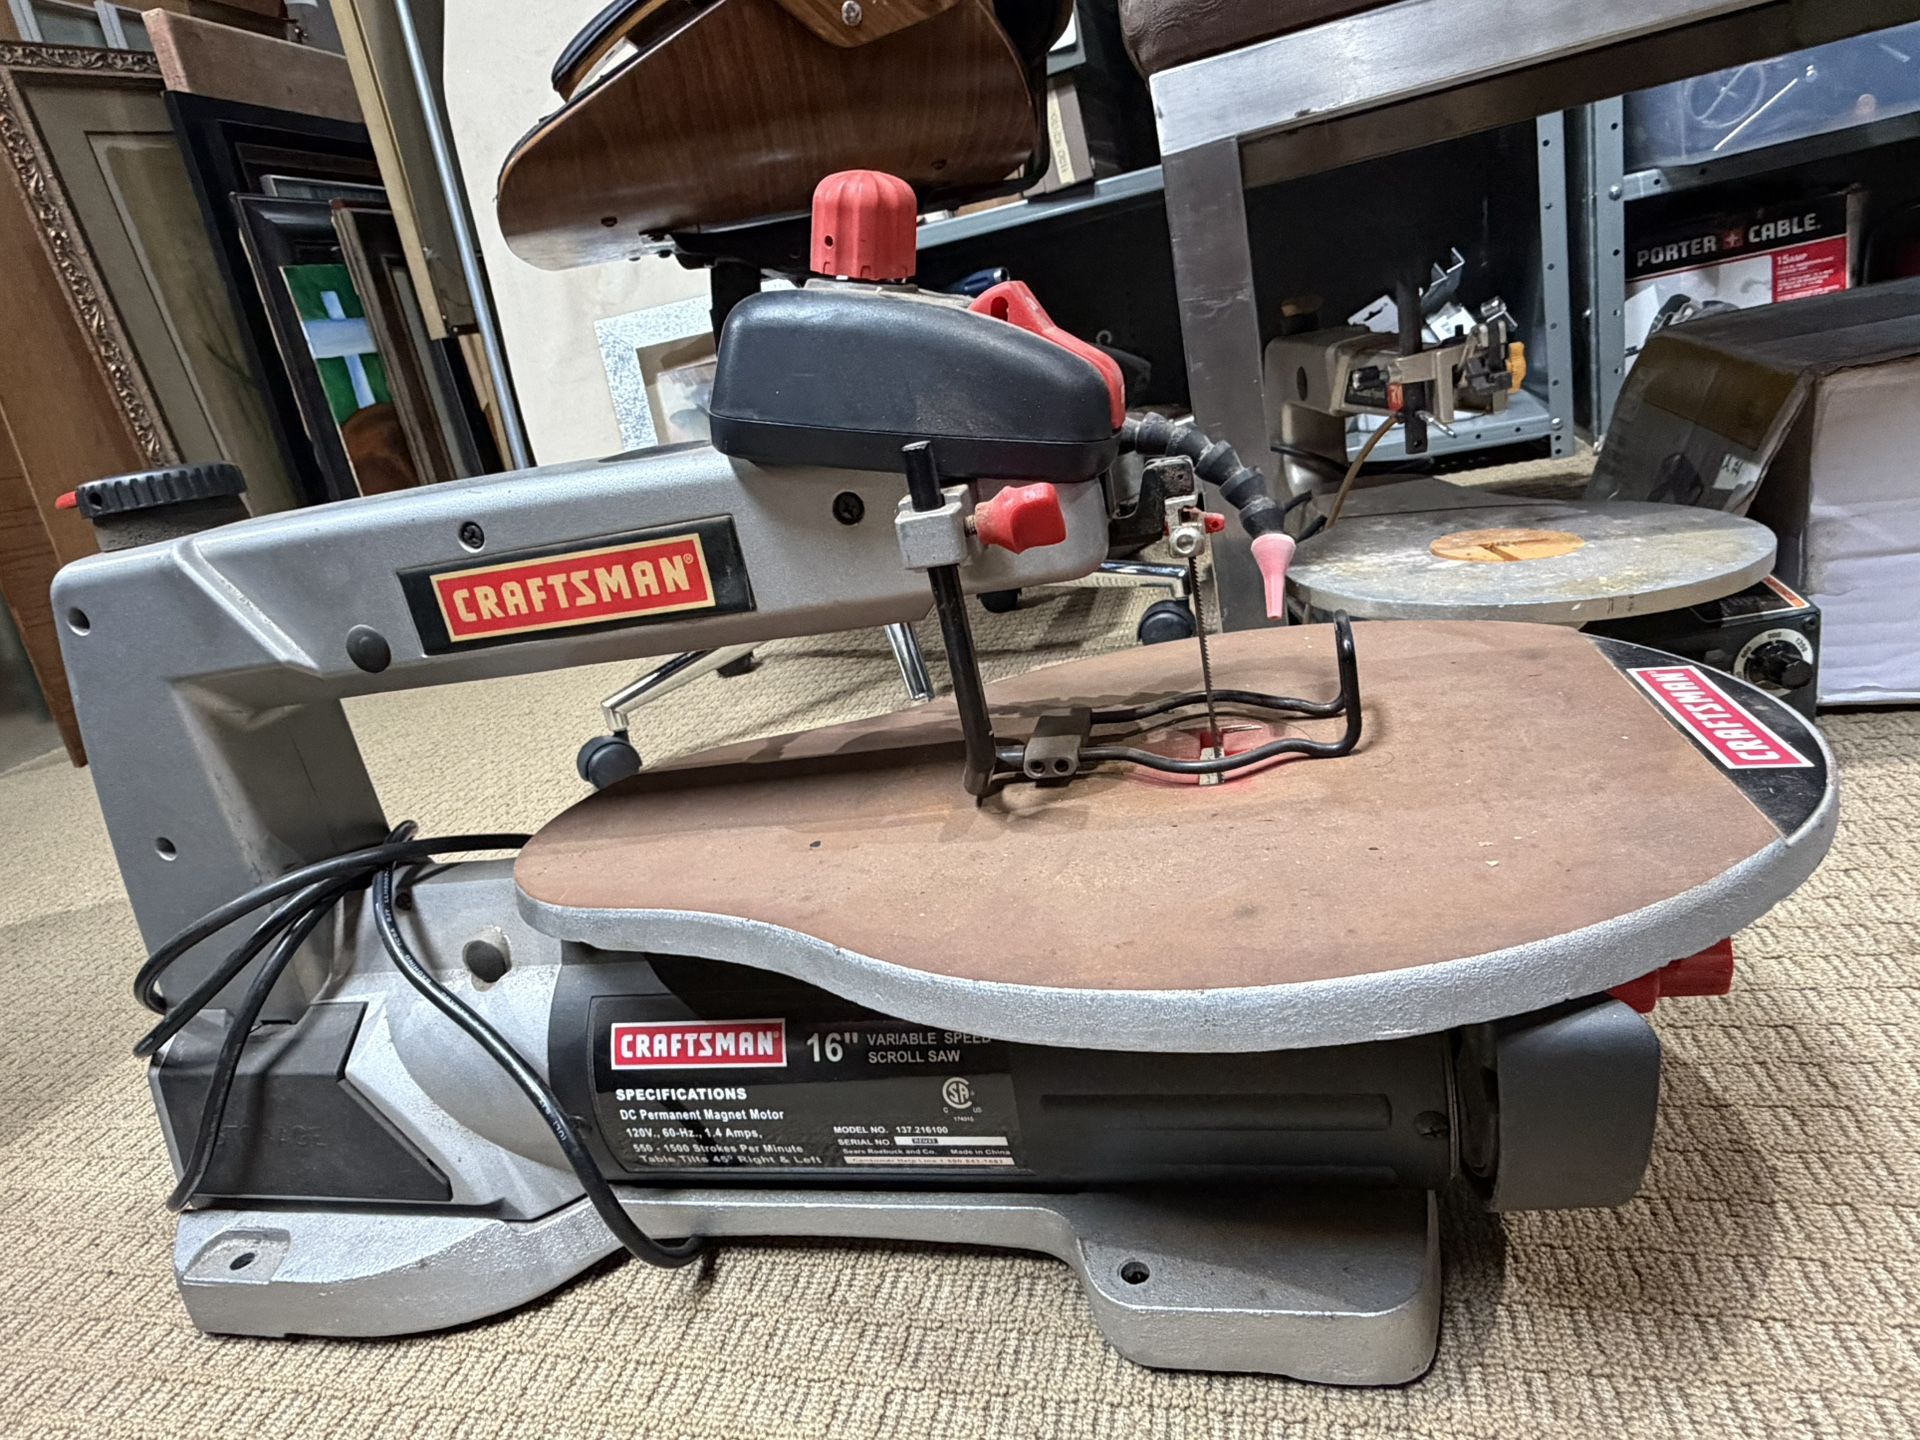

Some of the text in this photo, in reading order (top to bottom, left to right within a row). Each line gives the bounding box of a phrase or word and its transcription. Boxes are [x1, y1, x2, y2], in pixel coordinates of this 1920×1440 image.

[1636, 213, 1817, 268] PORTER CABLE
[453, 554, 691, 623] CRAFTSMAN
[1652, 671, 1781, 761] CRAFTSMAN
[620, 1030, 774, 1058] CRAFTSMAN
[867, 1032, 937, 1045] VARIABLE
[868, 1050, 960, 1063] SCROLL SAW
[615, 1087, 748, 1101] SPECIFICATIONS
[619, 1108, 784, 1122] DC Permanent Magnet Motor
[704, 1127, 722, 1138] 1.4
[833, 1126, 869, 1134] MODEL
[870, 1126, 889, 1134] NO.
[632, 1143, 653, 1153] 550
[663, 1143, 690, 1153] 1500
[692, 1143, 737, 1153] Strokes
[739, 1144, 760, 1153] Per
[762, 1144, 804, 1153] Minute
[837, 1138, 874, 1146] SERIAL
[985, 1148, 1011, 1156] China
[638, 1154, 676, 1163] Table
[678, 1154, 709, 1163] Tilts
[737, 1155, 776, 1165] Right
[779, 1155, 791, 1163] &
[793, 1155, 822, 1164] Left
